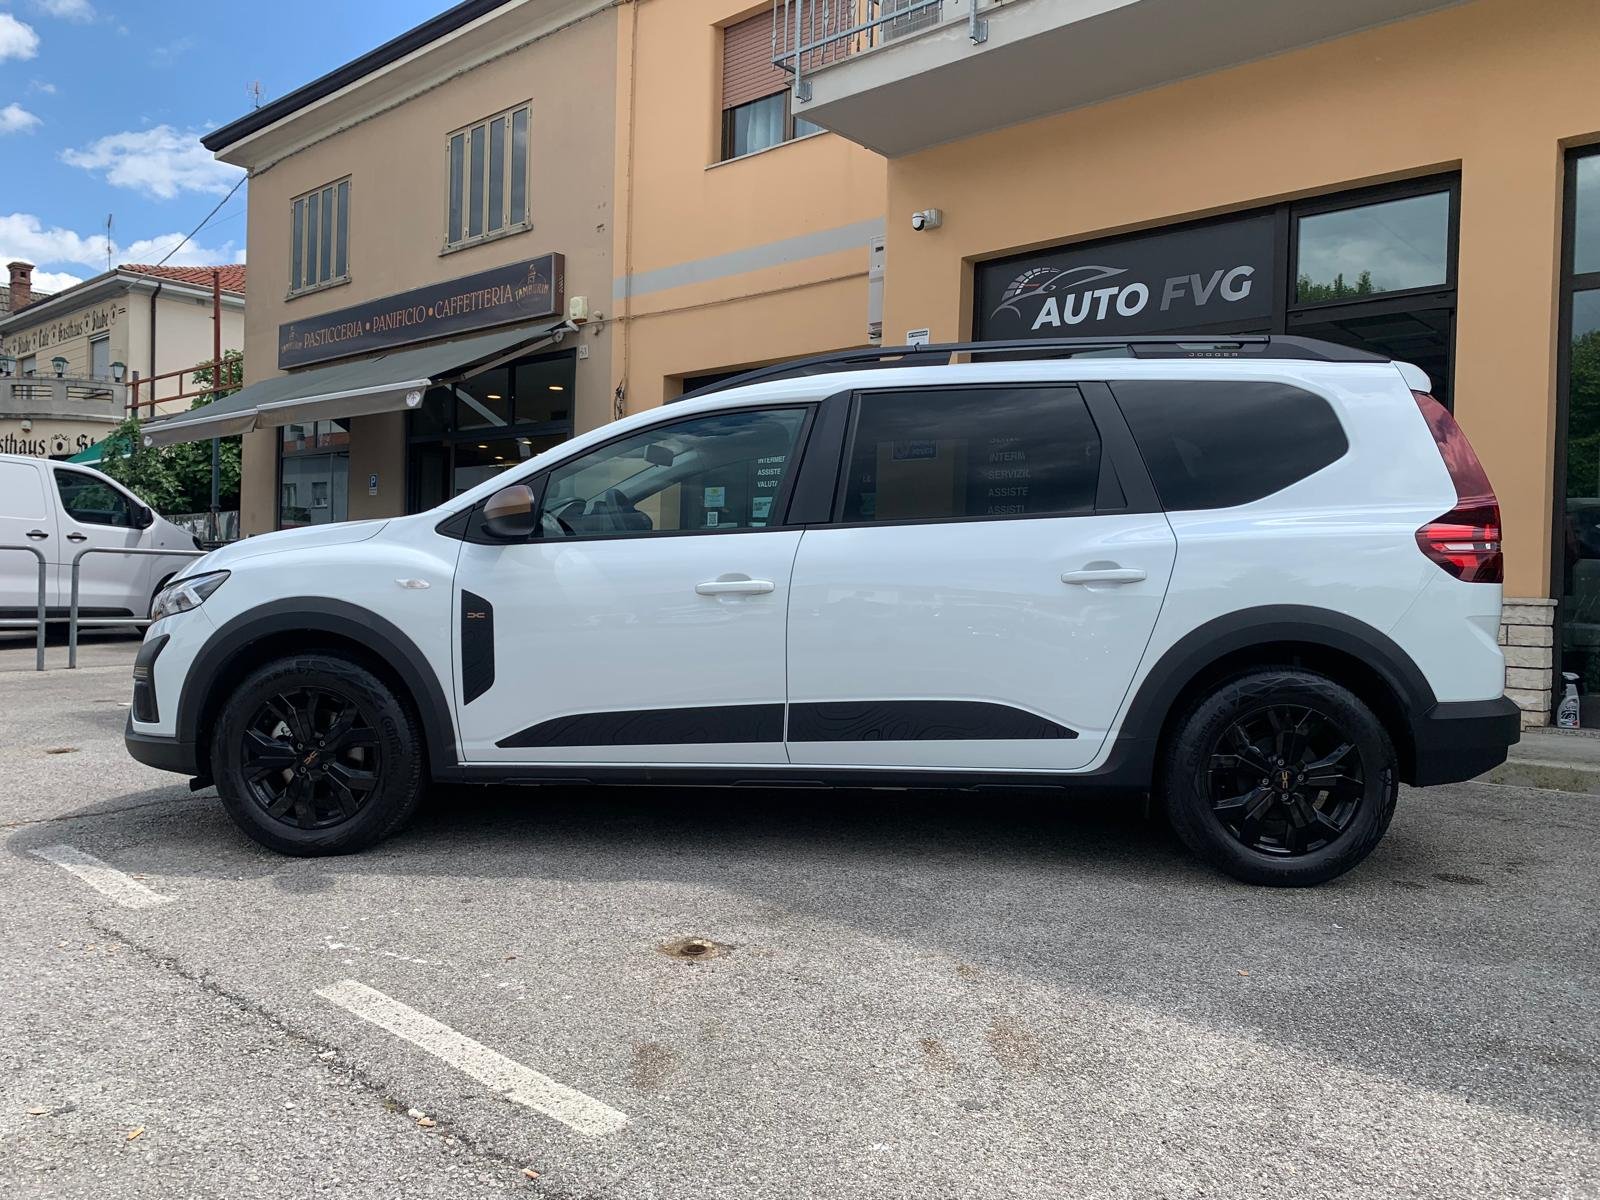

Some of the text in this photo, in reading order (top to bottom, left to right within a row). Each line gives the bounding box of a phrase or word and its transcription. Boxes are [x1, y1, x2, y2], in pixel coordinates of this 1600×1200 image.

[303, 320, 364, 349] PASTICCERIA
[372, 305, 426, 333] PANIFICIO
[434, 284, 513, 319] CAFFETTERIA
[1031, 265, 1255, 331] AUTO FVG
